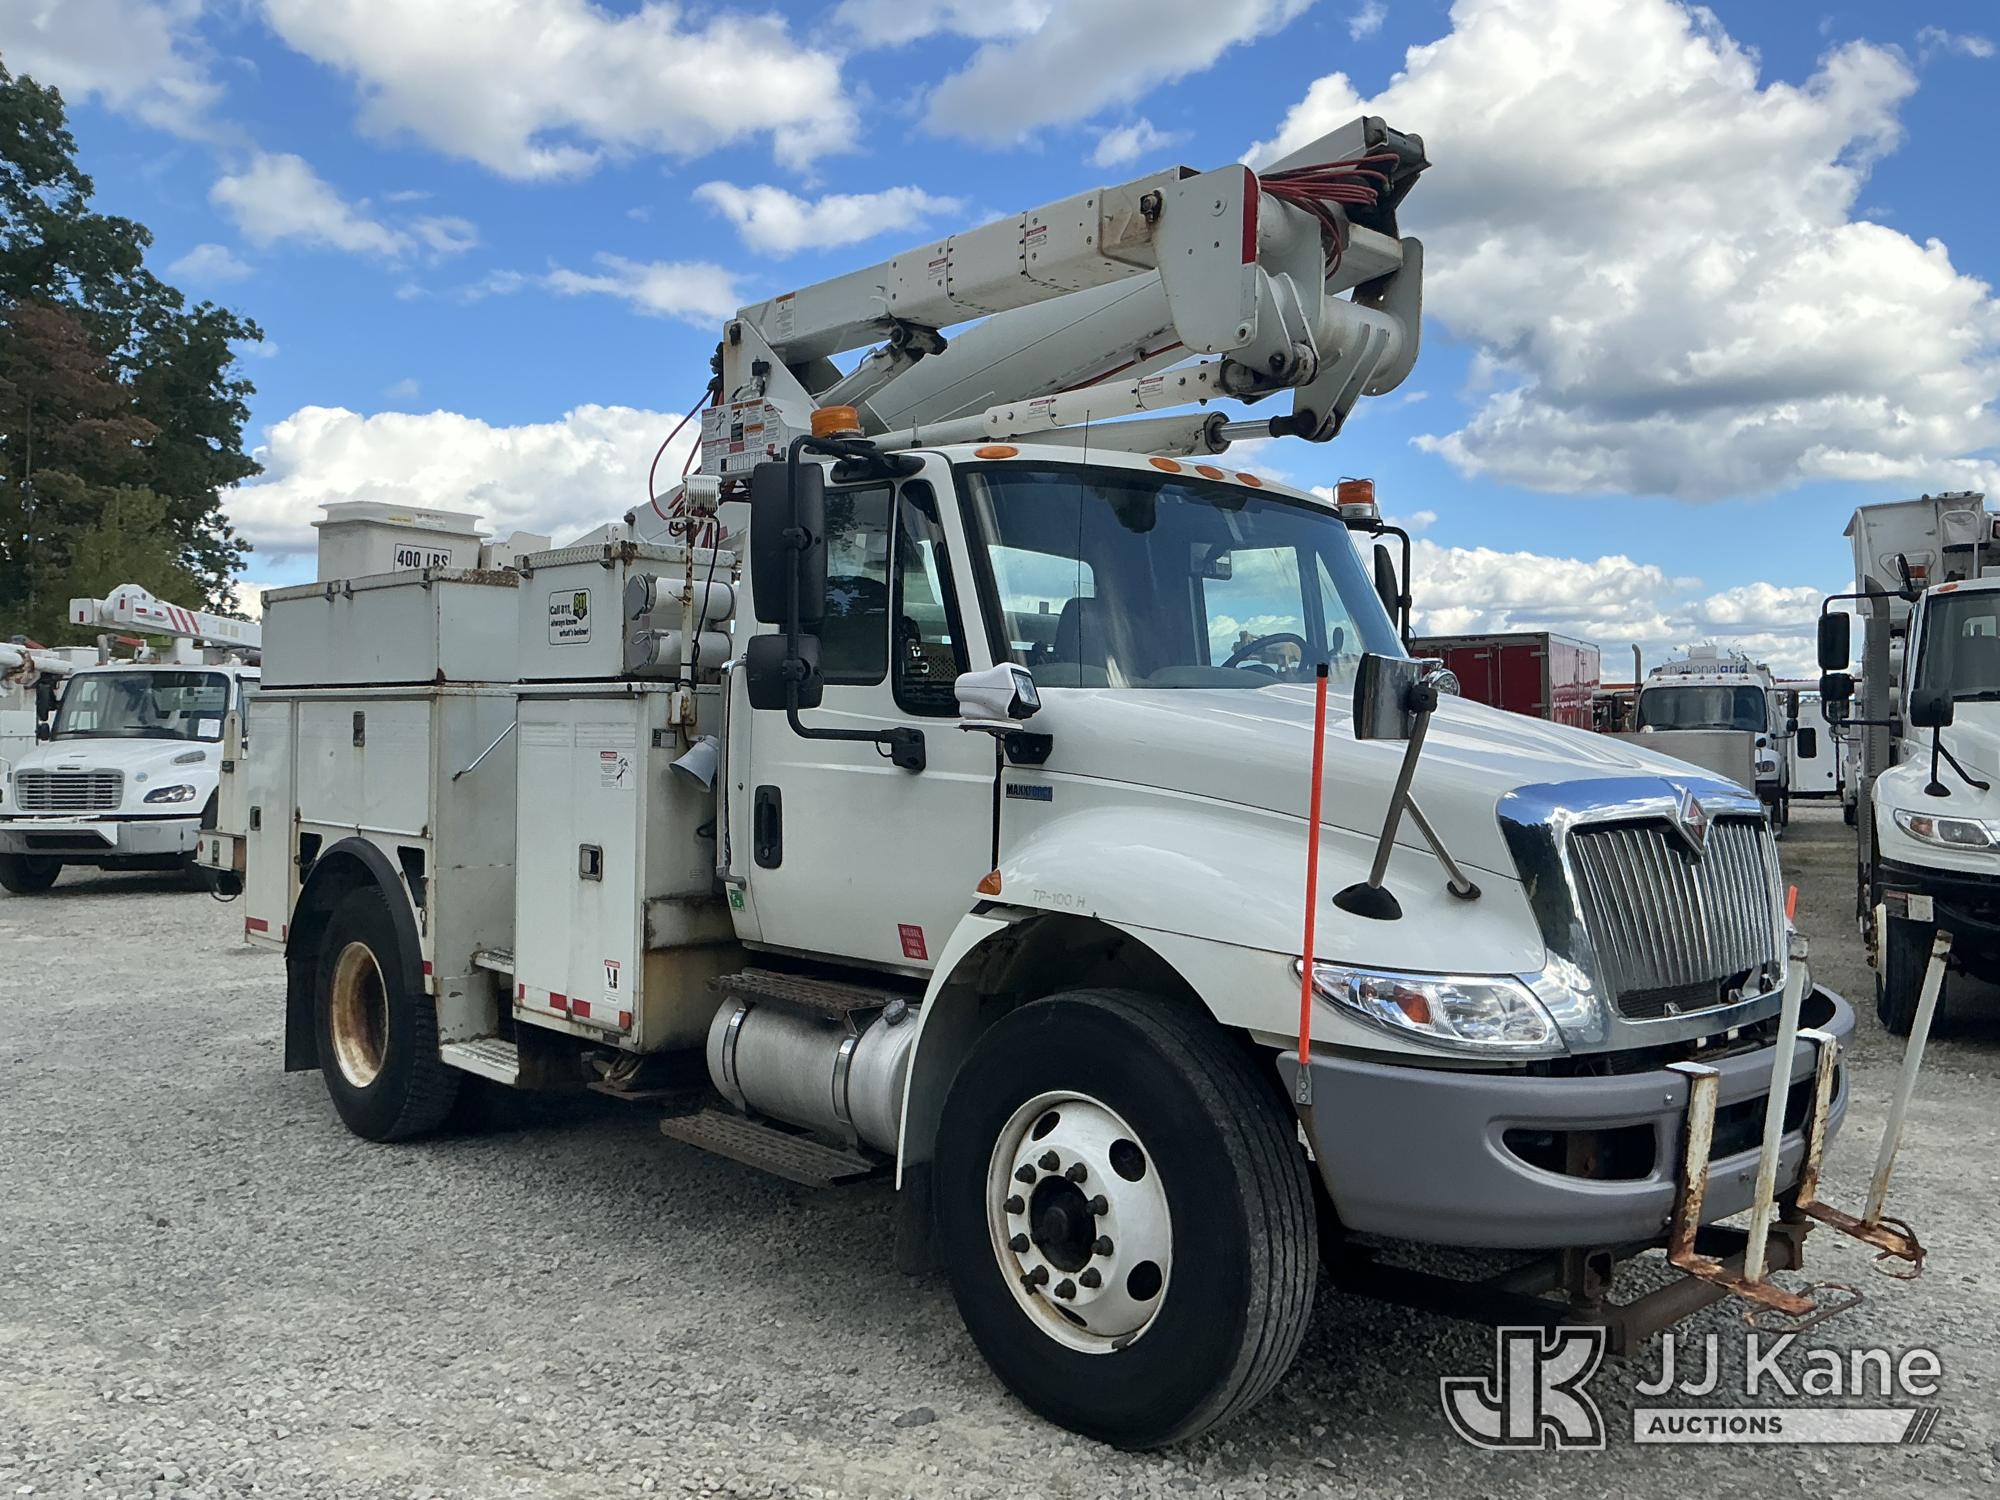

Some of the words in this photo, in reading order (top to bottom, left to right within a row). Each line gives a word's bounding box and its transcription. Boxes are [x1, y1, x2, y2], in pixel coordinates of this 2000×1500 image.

[397, 550, 421, 568] 400
[574, 593, 587, 610] 811
[550, 604, 561, 615] Call
[1077, 895, 1086, 908] H
